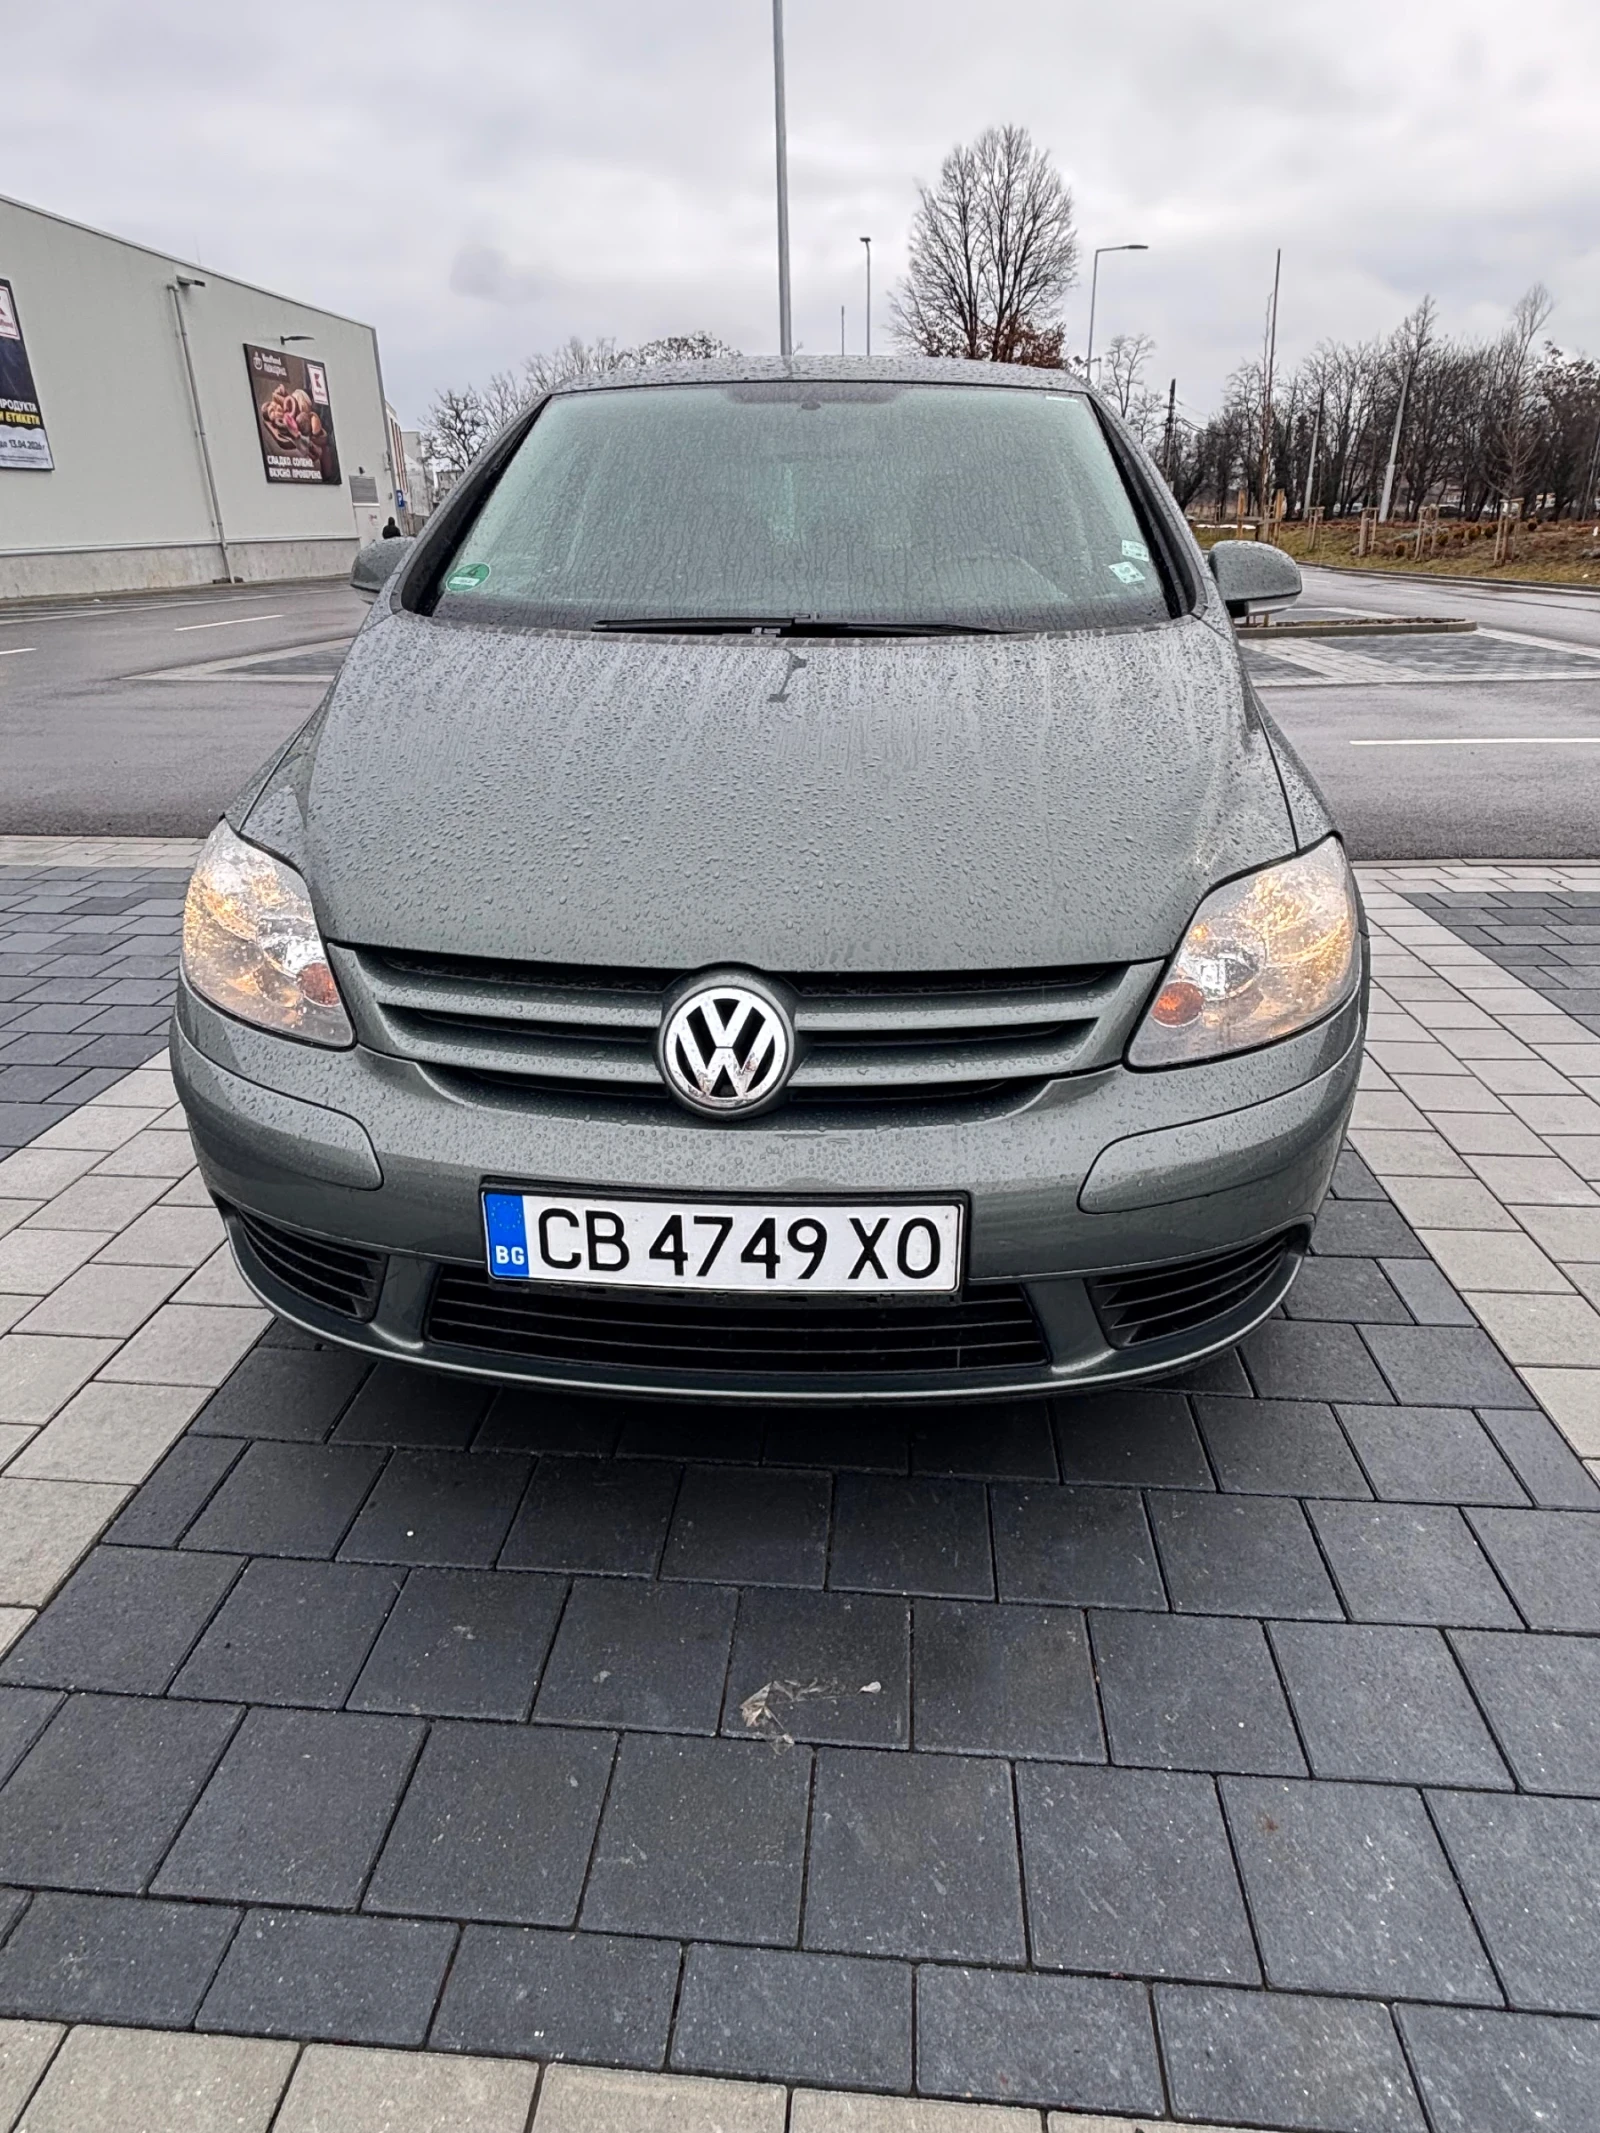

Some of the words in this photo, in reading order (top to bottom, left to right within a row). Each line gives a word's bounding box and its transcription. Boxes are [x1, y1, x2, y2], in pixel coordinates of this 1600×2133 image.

[494, 1245, 525, 1266] BG
[538, 1208, 631, 1272] CB
[648, 1214, 828, 1280] 4749
